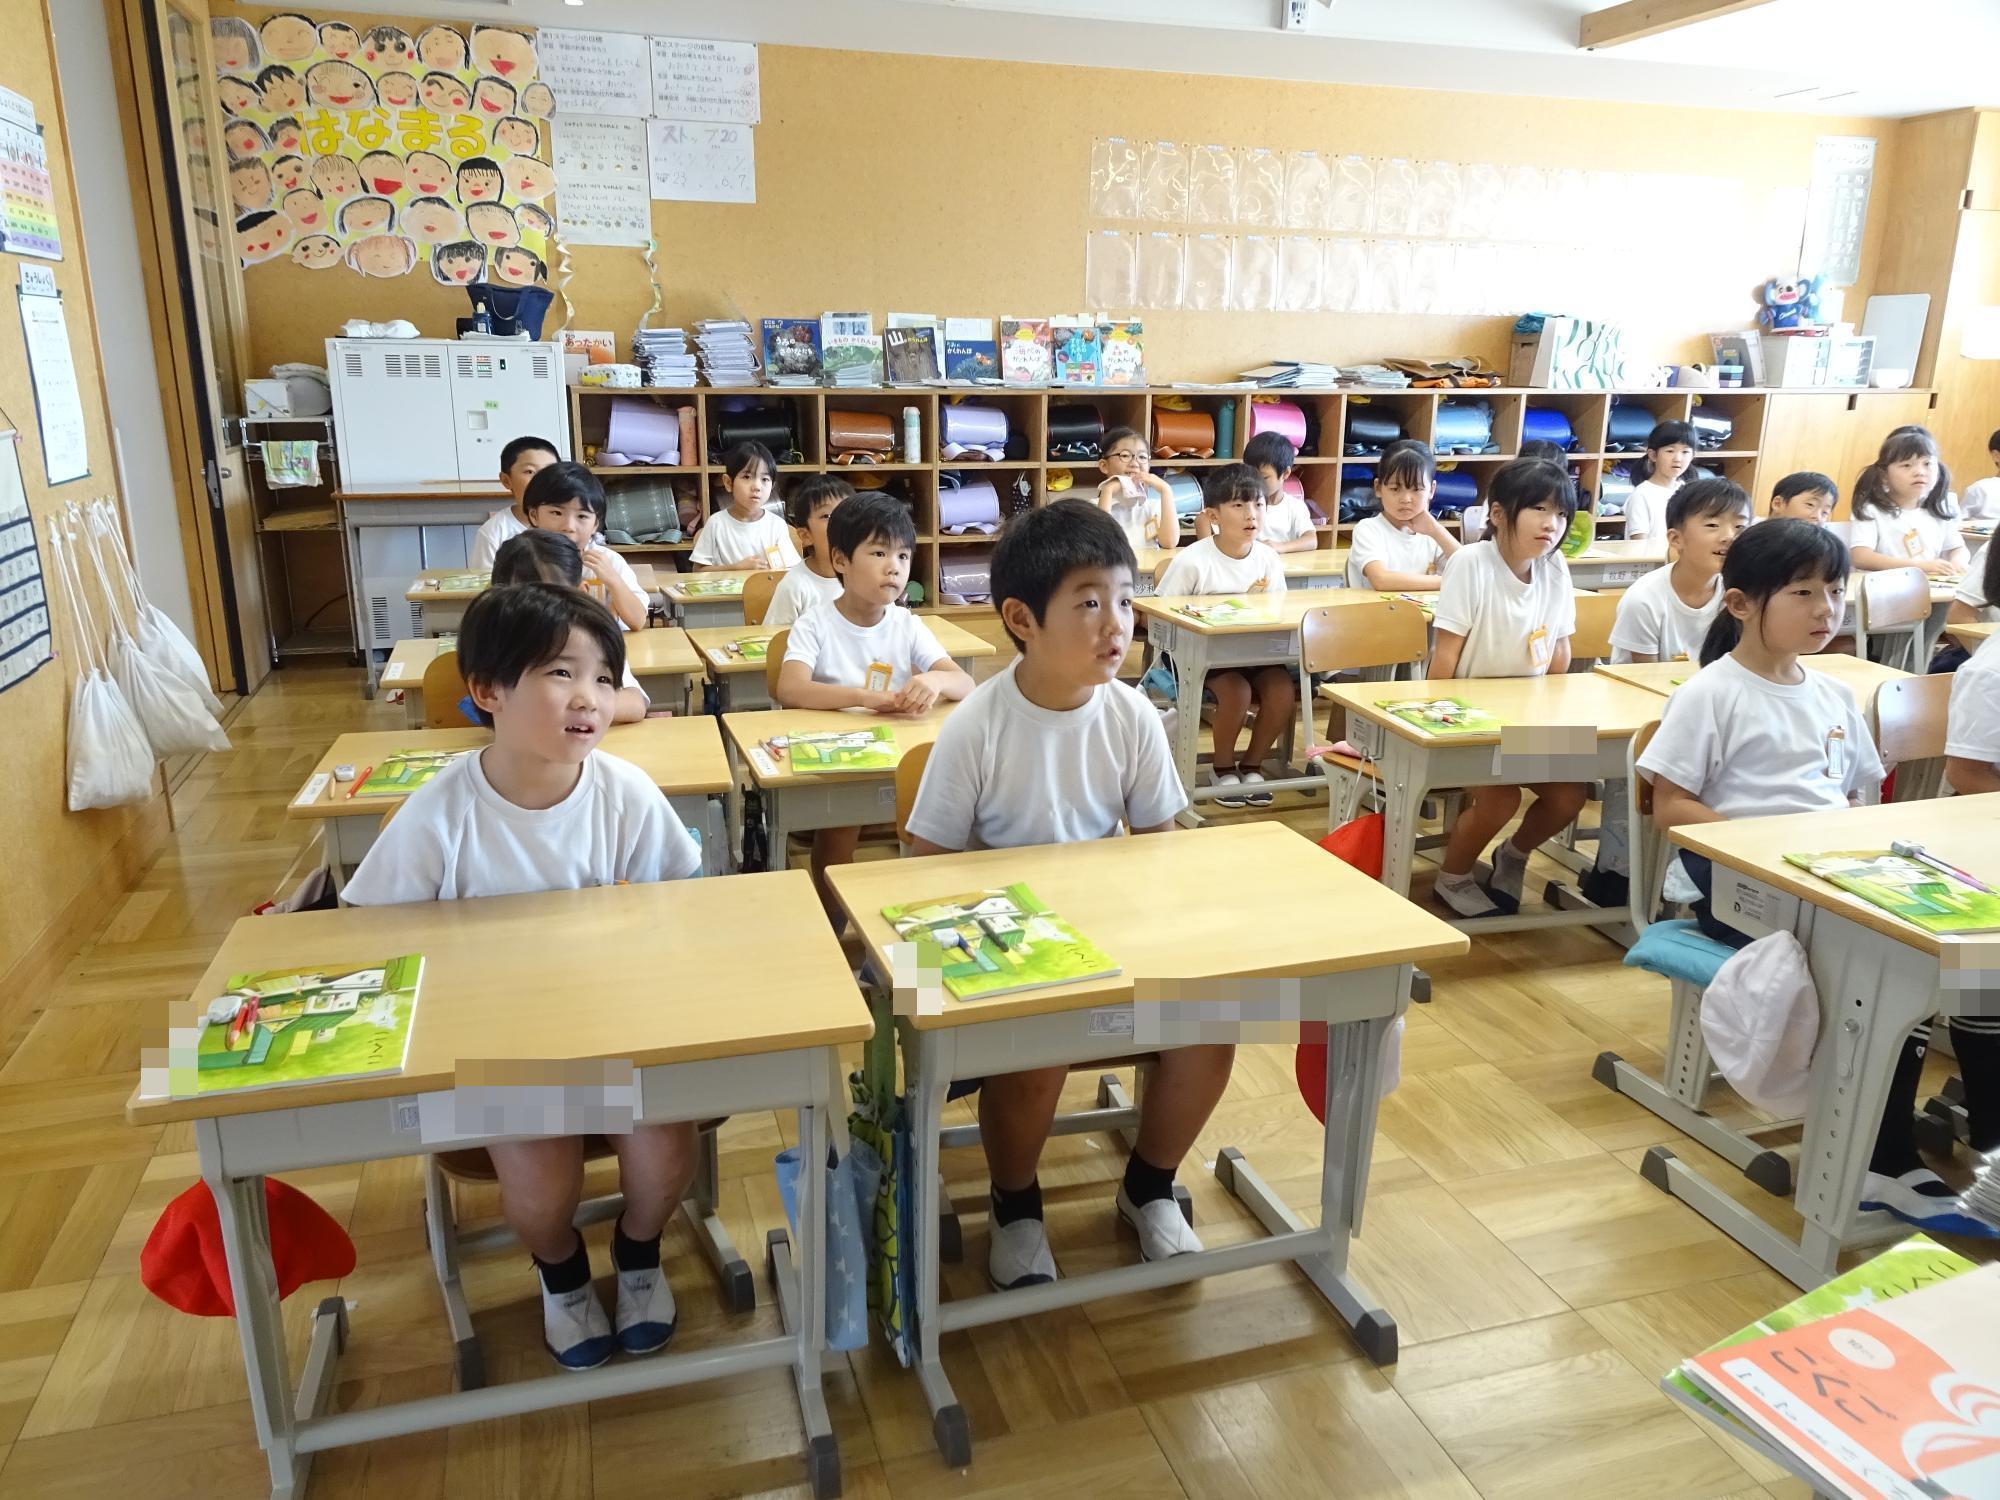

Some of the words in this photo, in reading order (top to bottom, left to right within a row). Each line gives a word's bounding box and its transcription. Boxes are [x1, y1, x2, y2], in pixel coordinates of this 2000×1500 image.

[541, 31, 603, 44] 第1ステージの目標
[654, 40, 715, 52] 第2ステージの目標
[294, 105, 487, 159] はなまる
[776, 336, 796, 346] うみの
[1770, 1346, 1898, 1425] こくご
